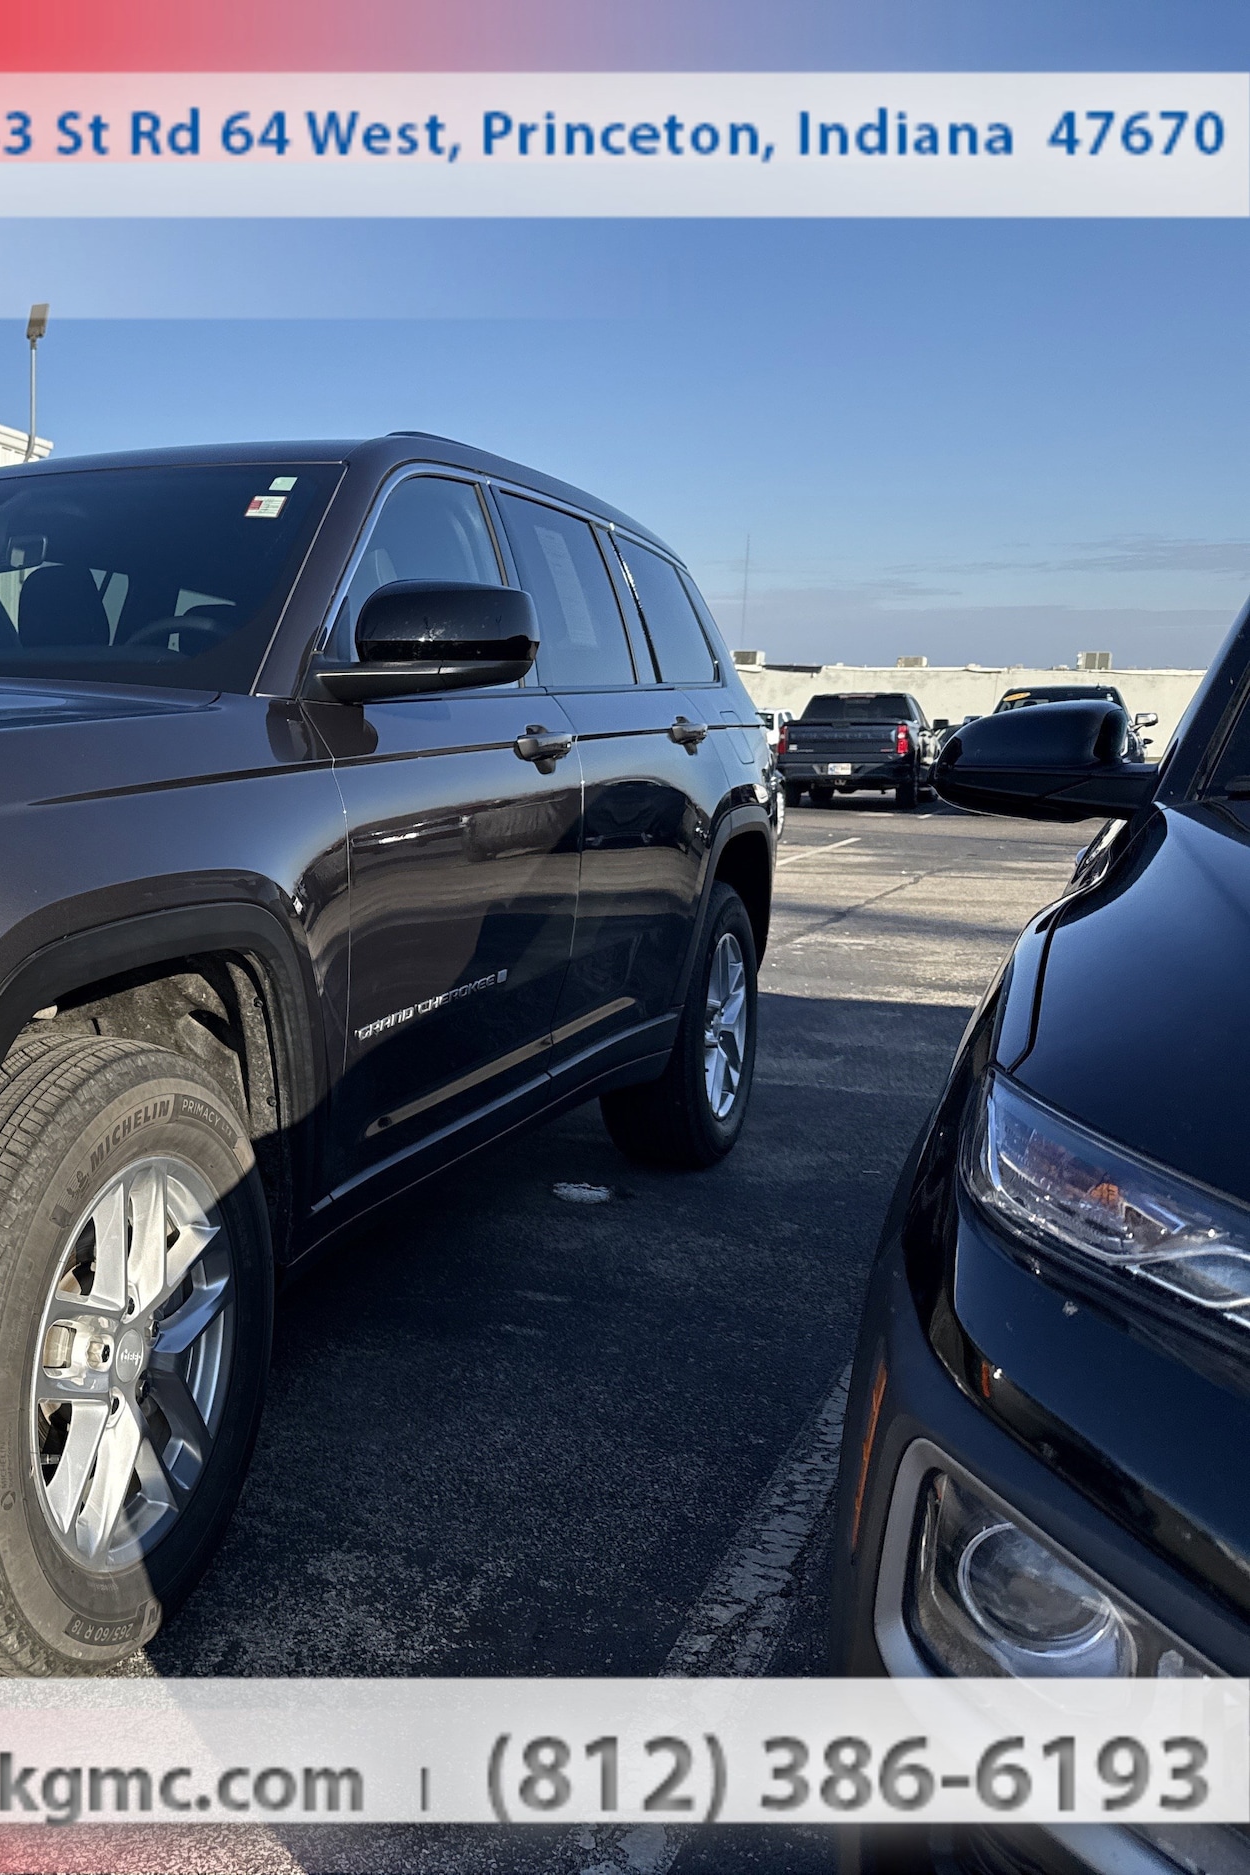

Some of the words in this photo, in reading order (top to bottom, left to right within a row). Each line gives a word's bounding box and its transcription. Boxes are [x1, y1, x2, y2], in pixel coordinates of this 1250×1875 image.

[356, 1007, 414, 1041] GRAND
[416, 974, 496, 1014] CHEROKEE
[90, 1100, 170, 1172] MICHELIN
[181, 1099, 221, 1124] PRIMACY
[71, 1619, 85, 1635] 18
[84, 1624, 95, 1639] R
[94, 1622, 134, 1642] 265/60
